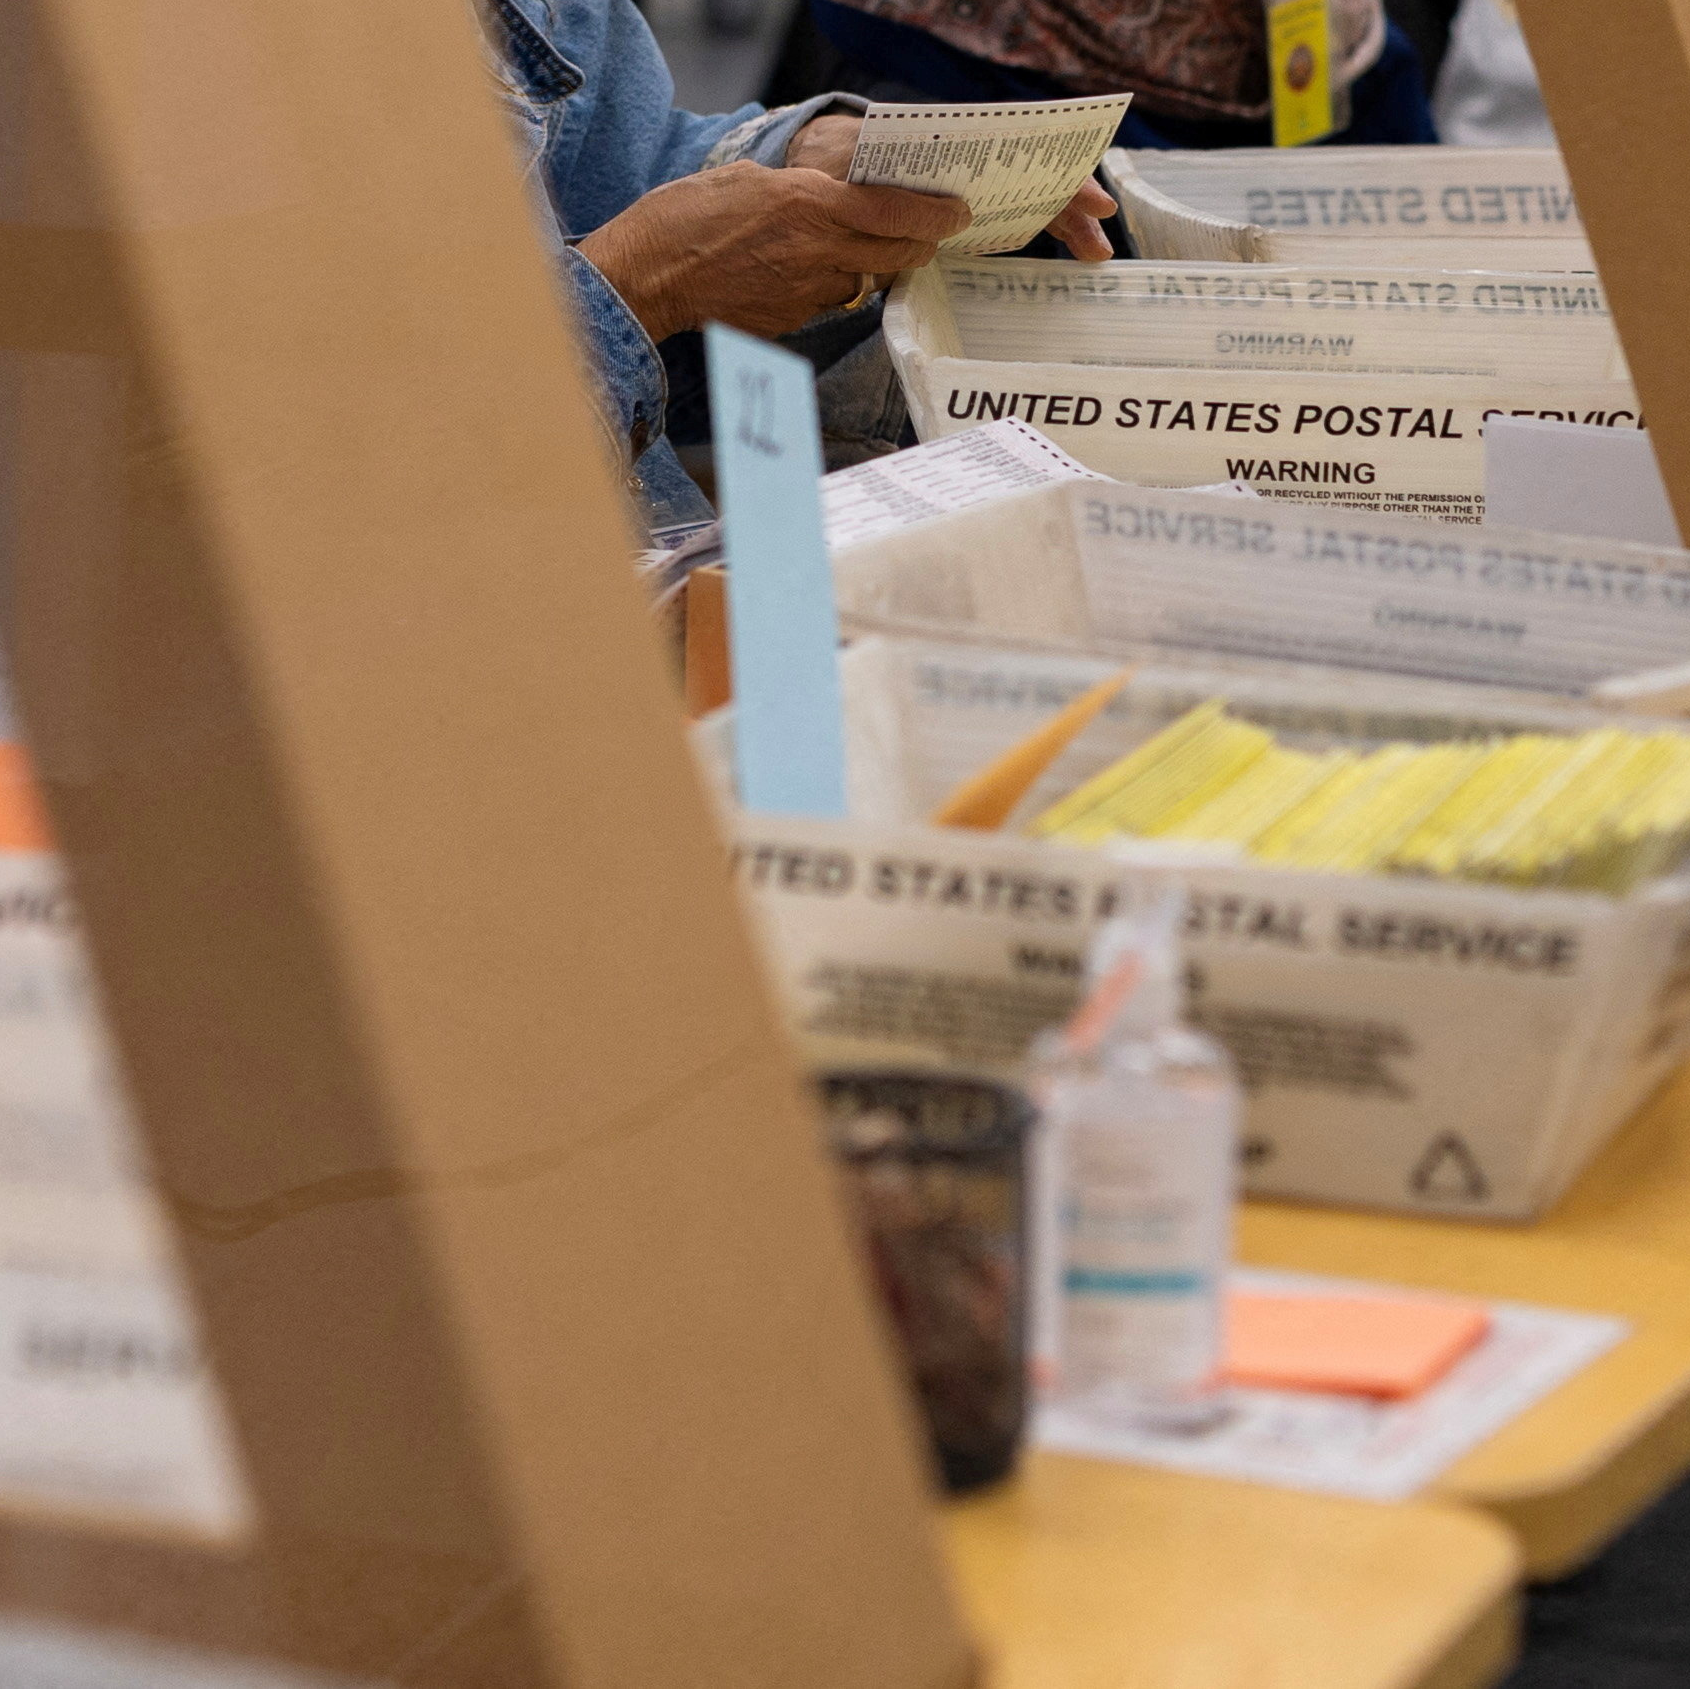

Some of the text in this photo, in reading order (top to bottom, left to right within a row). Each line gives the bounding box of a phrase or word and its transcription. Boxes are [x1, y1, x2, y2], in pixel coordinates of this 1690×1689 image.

[947, 389, 1103, 427] UNITED
[1114, 397, 1282, 435] STATES
[1293, 404, 1464, 439] POSTAL
[1226, 458, 1376, 485] WARNING
[1256, 488, 1272, 498] OR
[1274, 489, 1331, 500] RECYCLED
[1333, 491, 1381, 501] WITHOUT
[1384, 492, 1404, 502] THE
[1407, 493, 1472, 504] PERMISSION
[1383, 503, 1419, 513] OTHER
[1422, 504, 1450, 514] THAN
[1453, 504, 1473, 514] THE
[869, 855, 1081, 918] STATES
[1339, 904, 1579, 979] SERVICE
